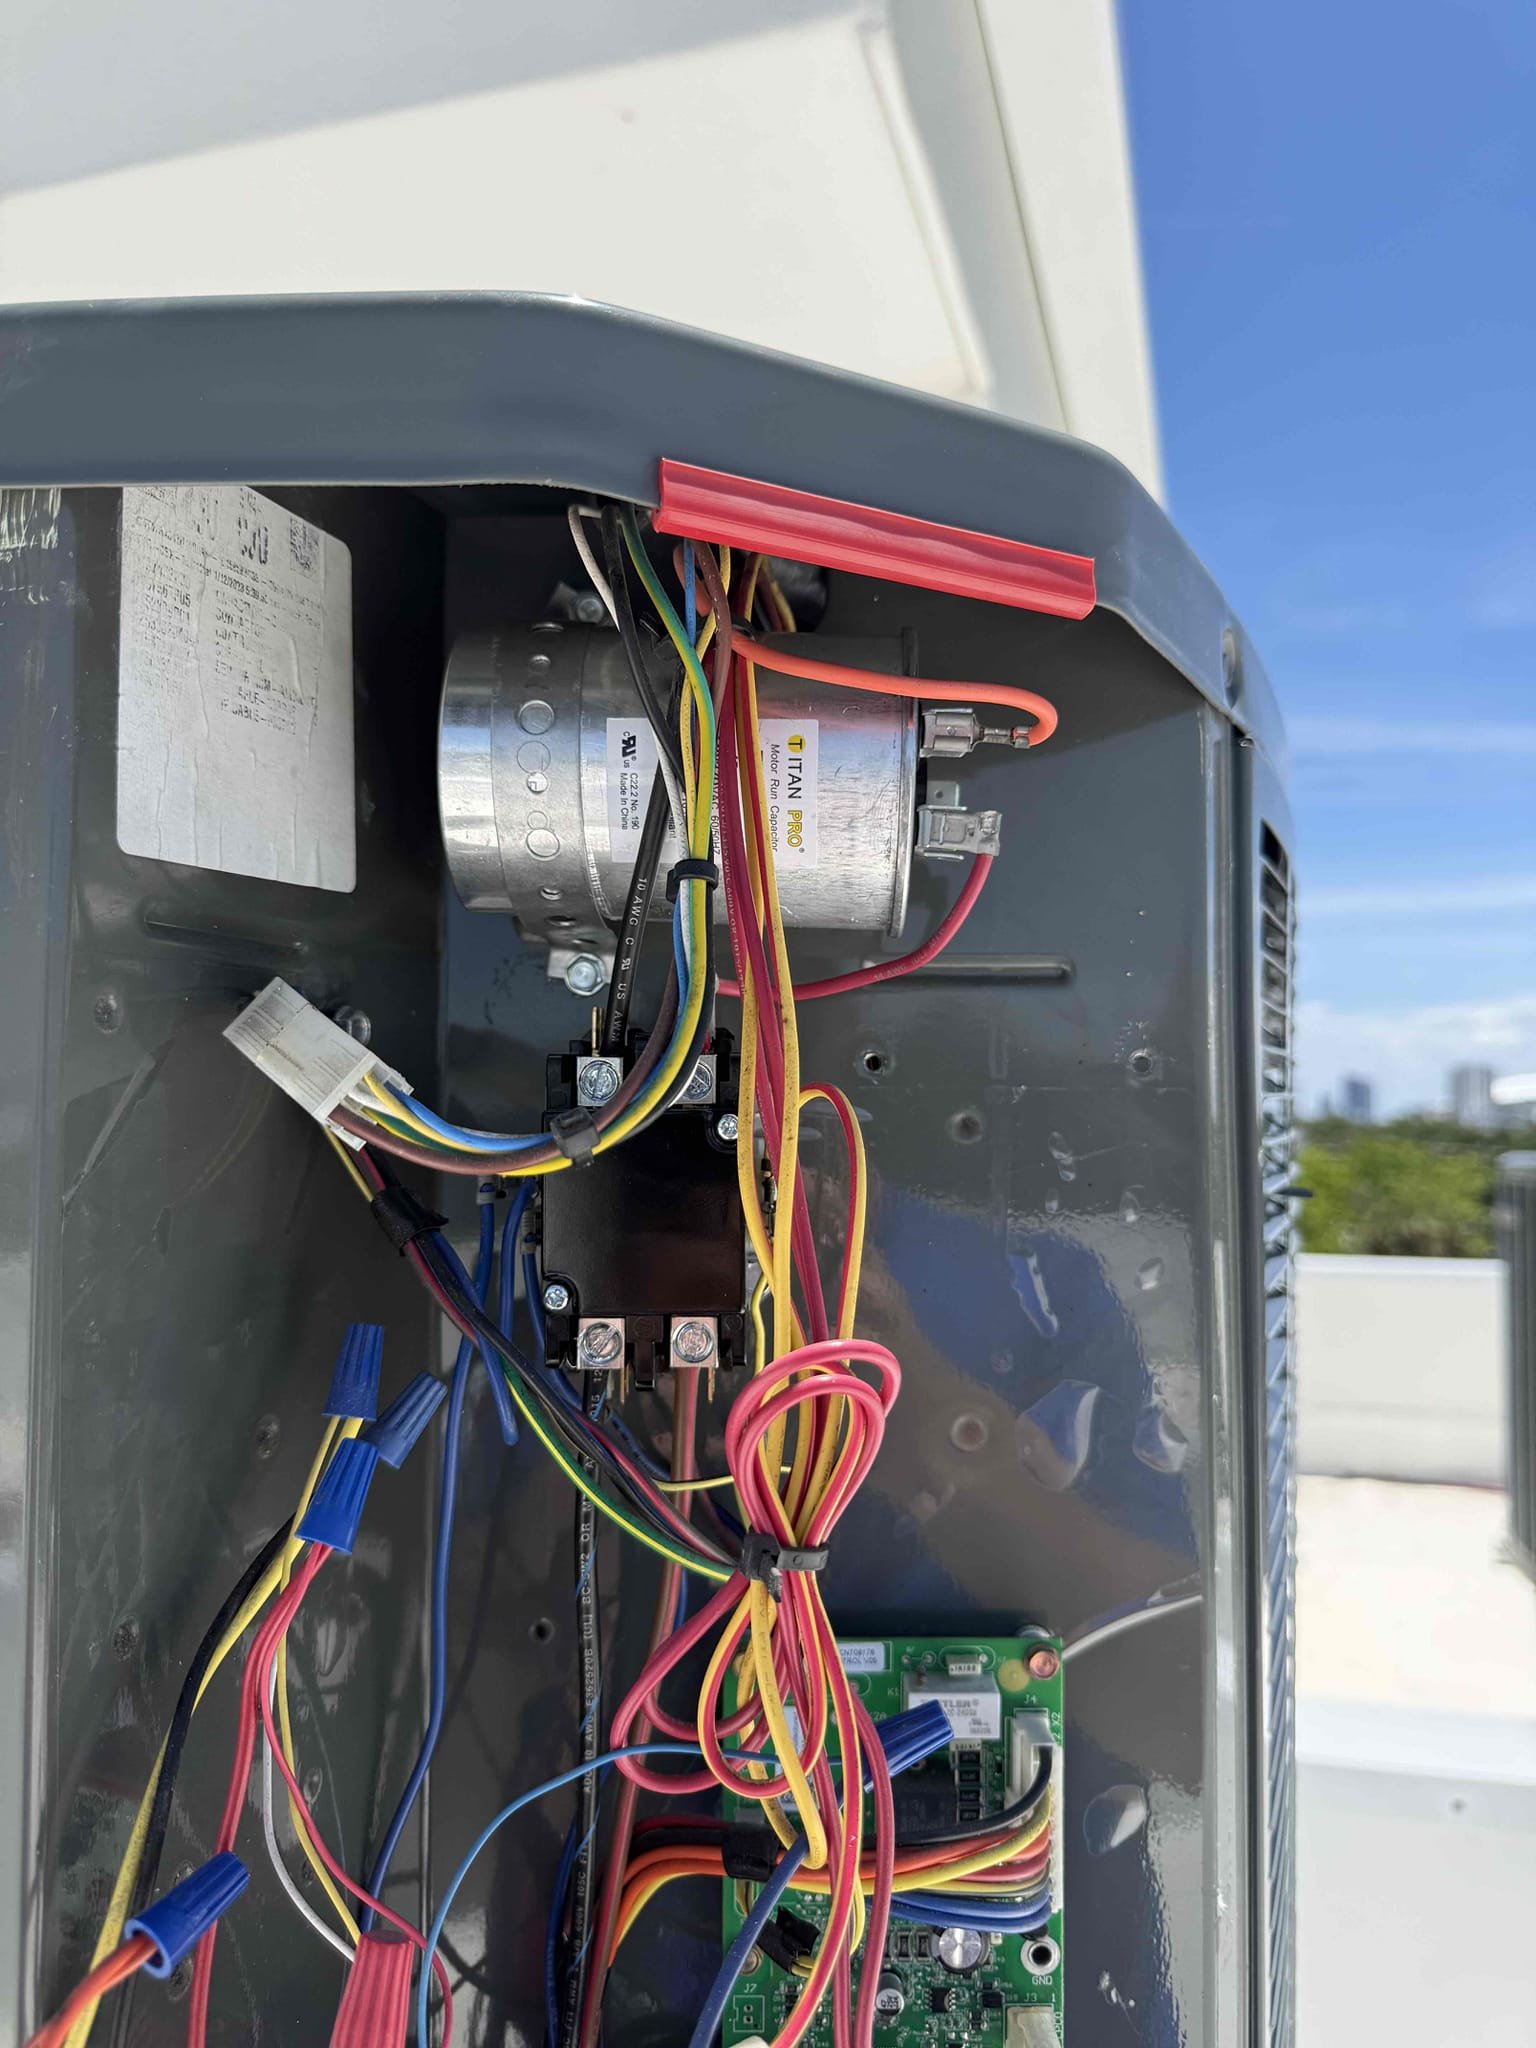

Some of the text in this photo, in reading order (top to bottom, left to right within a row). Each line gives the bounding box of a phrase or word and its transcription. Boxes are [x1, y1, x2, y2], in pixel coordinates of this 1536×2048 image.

[787, 735, 805, 799] TITAN
[619, 772, 630, 830] Made In China
[630, 772, 640, 830] C22.2 No. 190
[768, 744, 780, 853] Motor Run Capacitor
[637, 877, 648, 891] 10
[629, 895, 644, 926] AWG
[616, 983, 627, 1000] US
[581, 1522, 590, 1542] OR
[1031, 1975, 1053, 1985] GND
